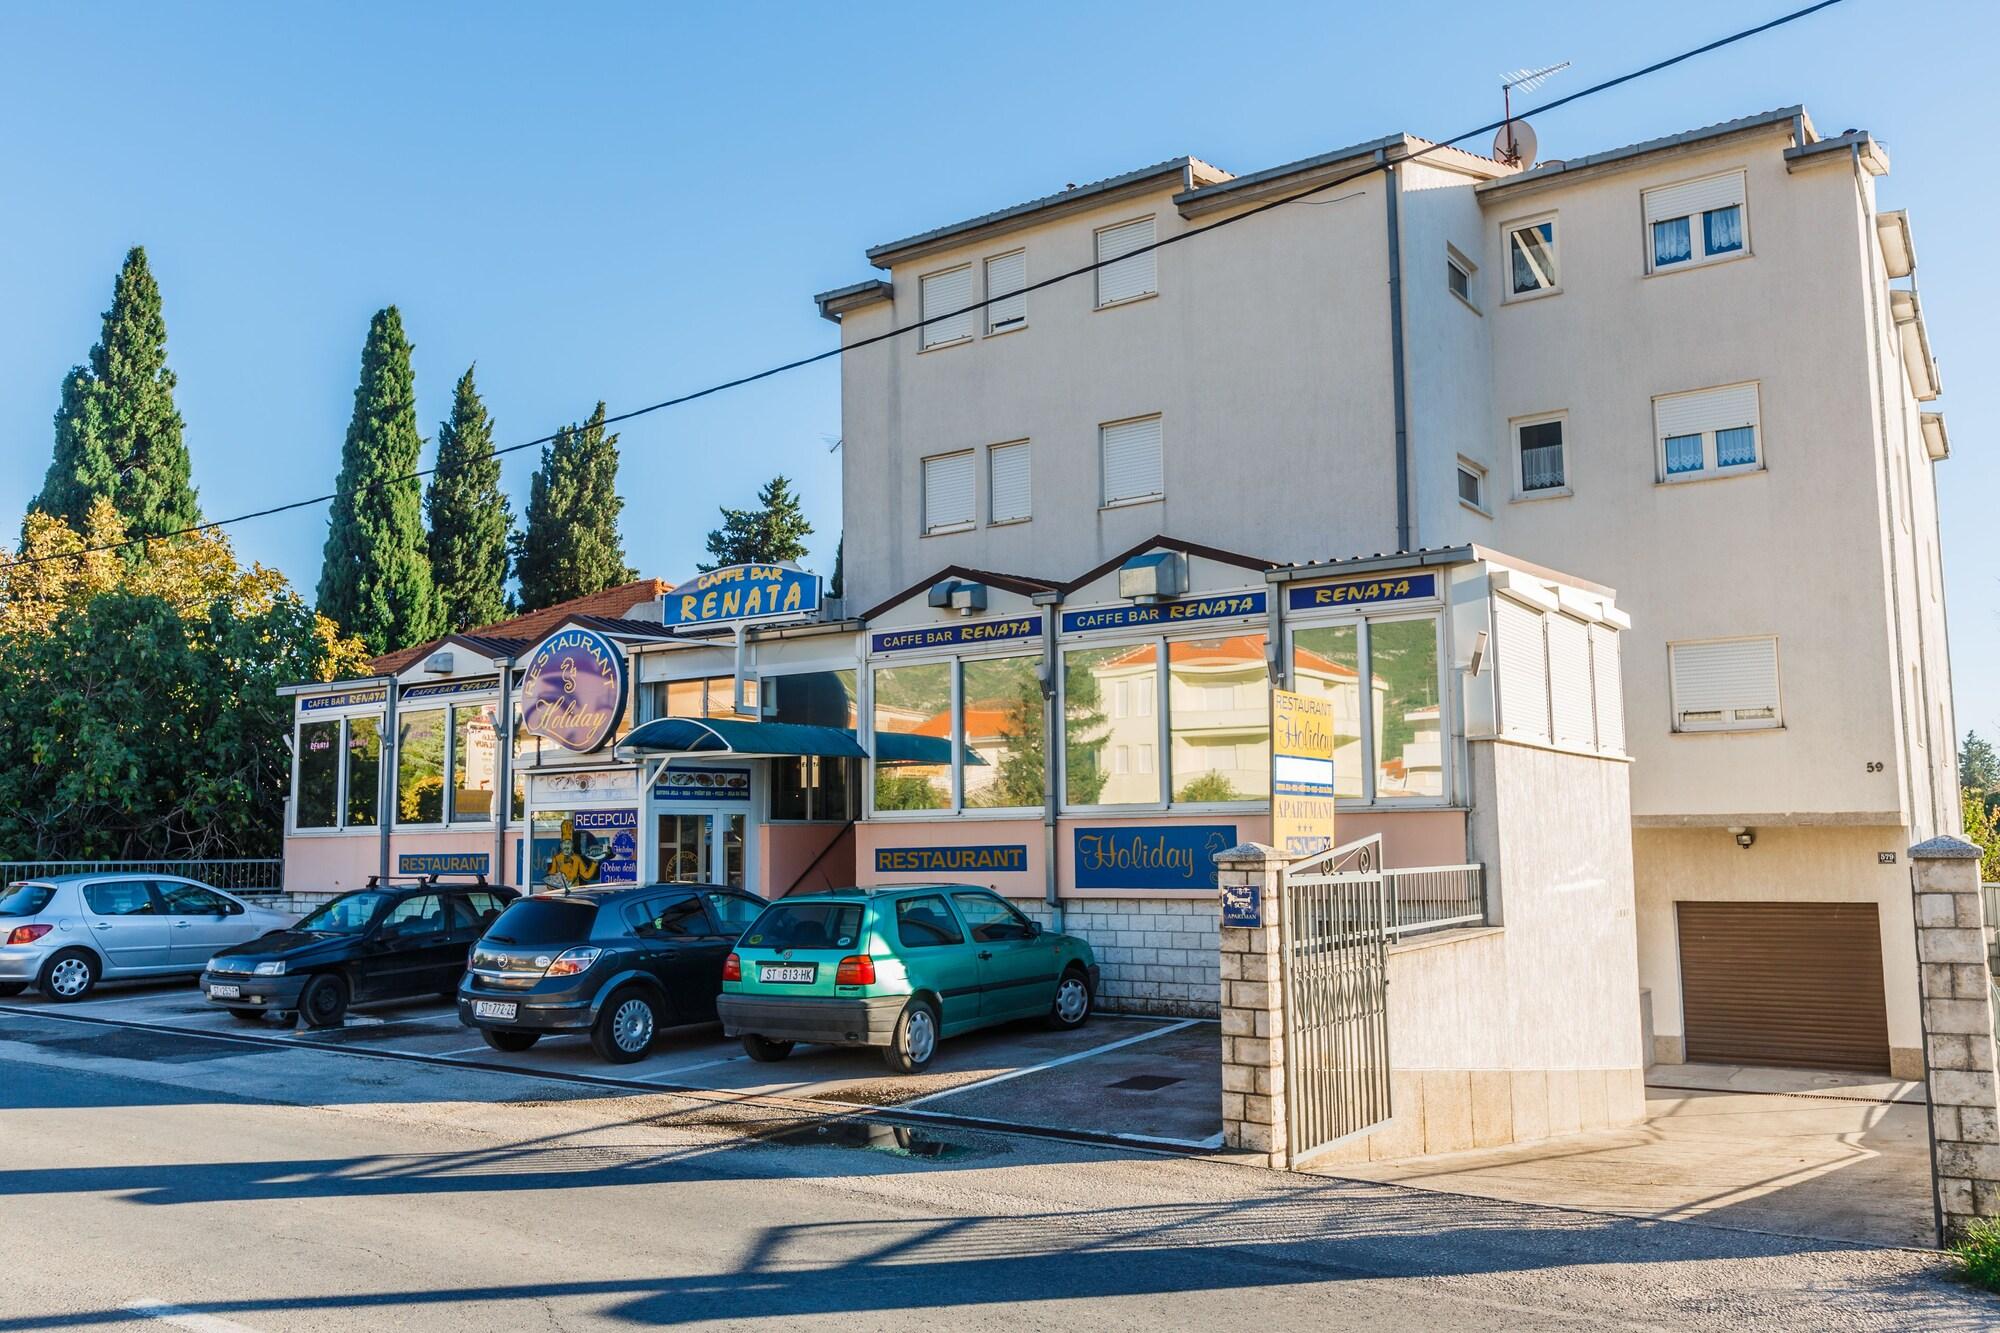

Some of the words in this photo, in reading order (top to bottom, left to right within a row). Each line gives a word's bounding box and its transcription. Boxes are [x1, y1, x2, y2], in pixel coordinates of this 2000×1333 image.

[698, 568, 744, 590] CAFFE
[750, 567, 783, 581] BAR
[681, 581, 801, 621] RENATA
[1315, 580, 1410, 603] RENATA
[1076, 612, 1123, 627] CAFFE
[1128, 609, 1159, 622] BAR
[1169, 597, 1253, 619] RENATA
[883, 634, 923, 648] CAFFE
[927, 631, 953, 643] BAR
[961, 620, 1031, 640] RENATA
[525, 634, 615, 697] RESTAURANT
[307, 698, 330, 708] CAFFE
[330, 697, 346, 706] BAR
[349, 691, 387, 704] RENATA
[411, 687, 437, 697] CAFFE
[438, 685, 457, 694] BAR
[528, 696, 608, 738] Holiday
[1276, 694, 1332, 717] RESTAURANT
[1276, 714, 1333, 758] Holiday
[1866, 761, 1884, 773] 59
[575, 812, 637, 826] RECEPCIJA
[400, 856, 488, 871] RESTAURANT
[878, 848, 1023, 870] RESTAURANT
[1078, 834, 1194, 878] Holiday
[536, 957, 548, 966] HR
[766, 968, 777, 980] ST
[480, 1002, 488, 1013] ST
